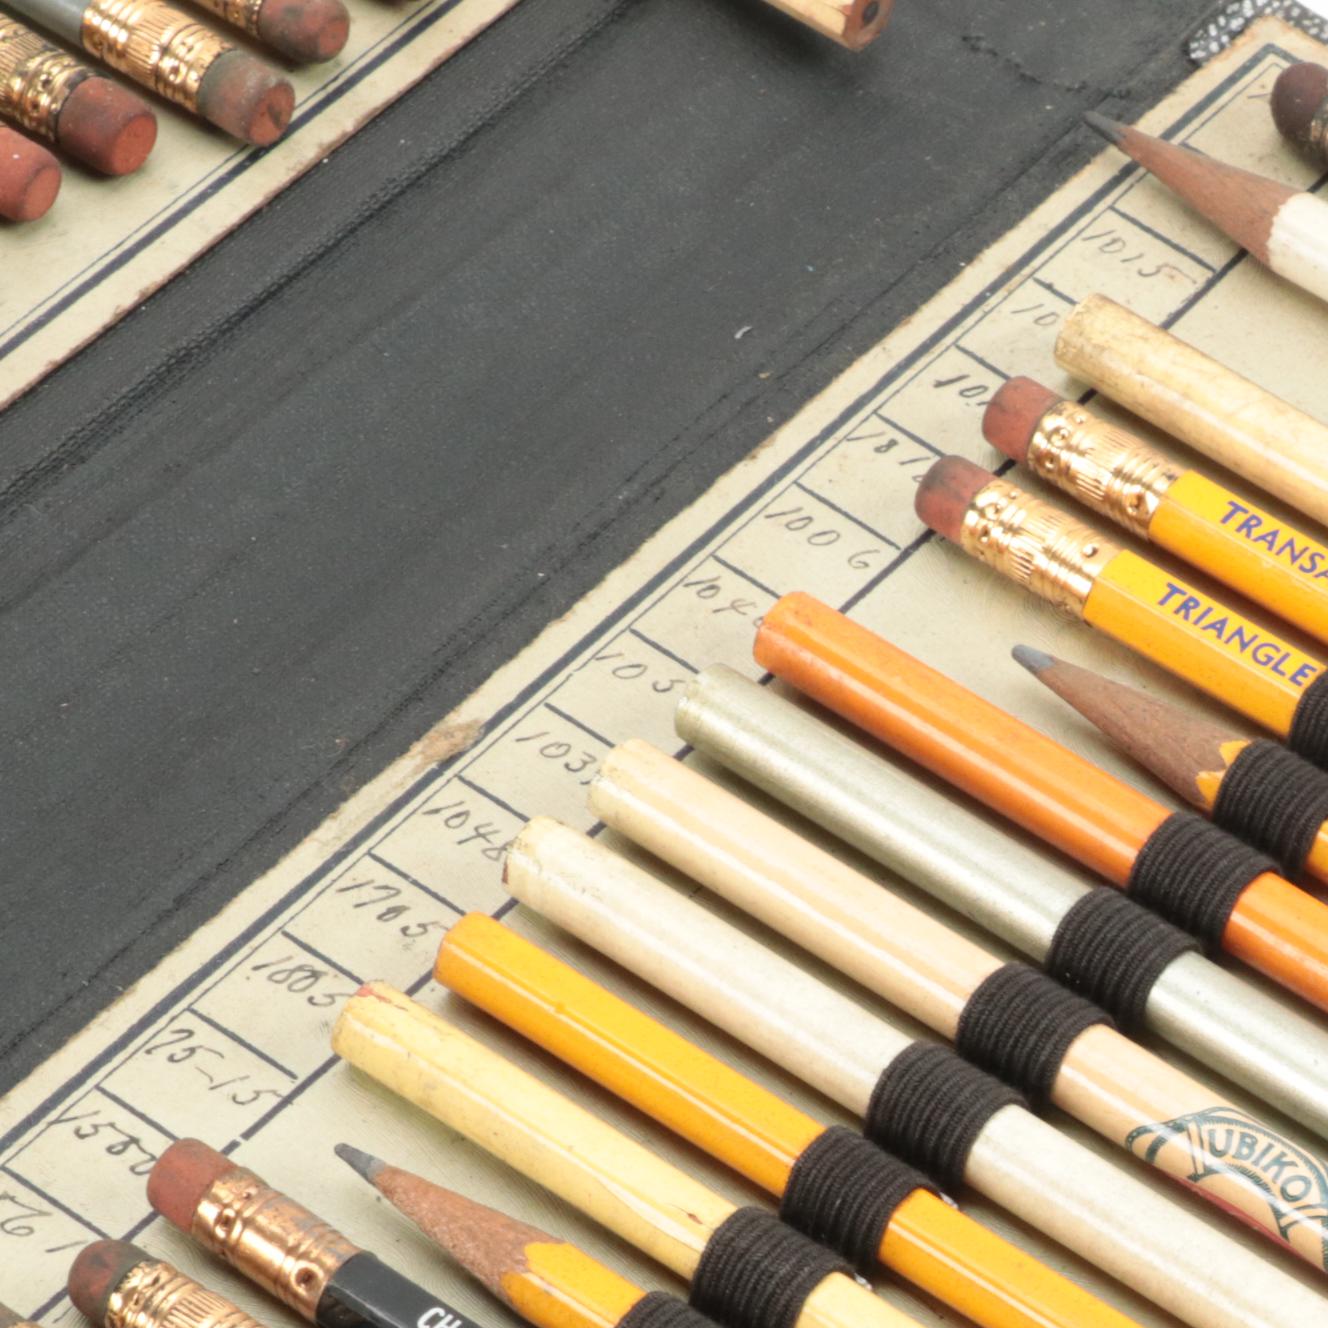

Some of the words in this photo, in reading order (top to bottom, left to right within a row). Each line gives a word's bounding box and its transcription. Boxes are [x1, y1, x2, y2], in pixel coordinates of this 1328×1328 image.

[763, 506, 881, 570] 1006
[1156, 581, 1318, 688] TRIANGLE
[1207, 1126, 1314, 1203] UBIKO
